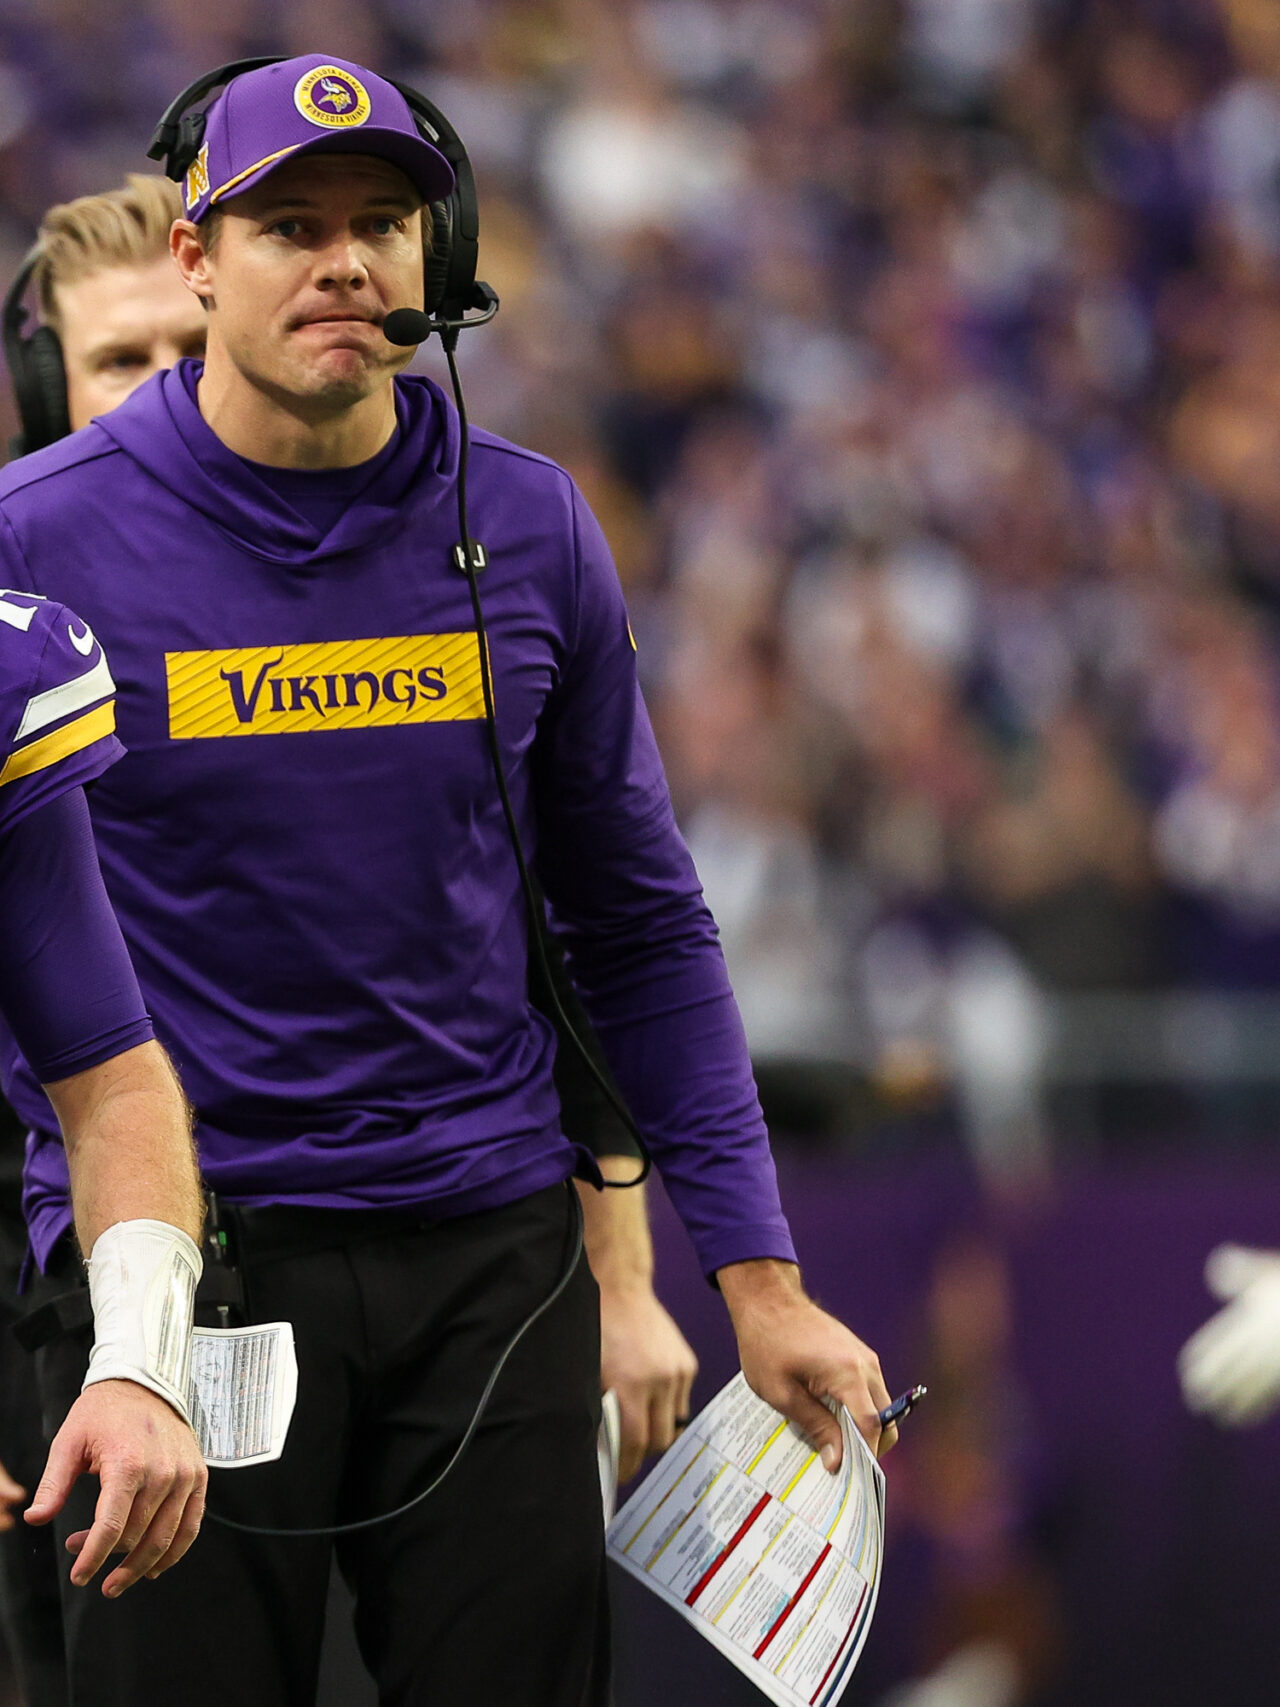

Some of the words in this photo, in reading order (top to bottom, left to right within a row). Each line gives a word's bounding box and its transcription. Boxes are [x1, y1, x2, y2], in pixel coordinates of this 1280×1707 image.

[302, 69, 336, 91] MINNESOTA
[305, 104, 345, 123] MINNESOTA
[220, 646, 447, 723] VIKINGS
